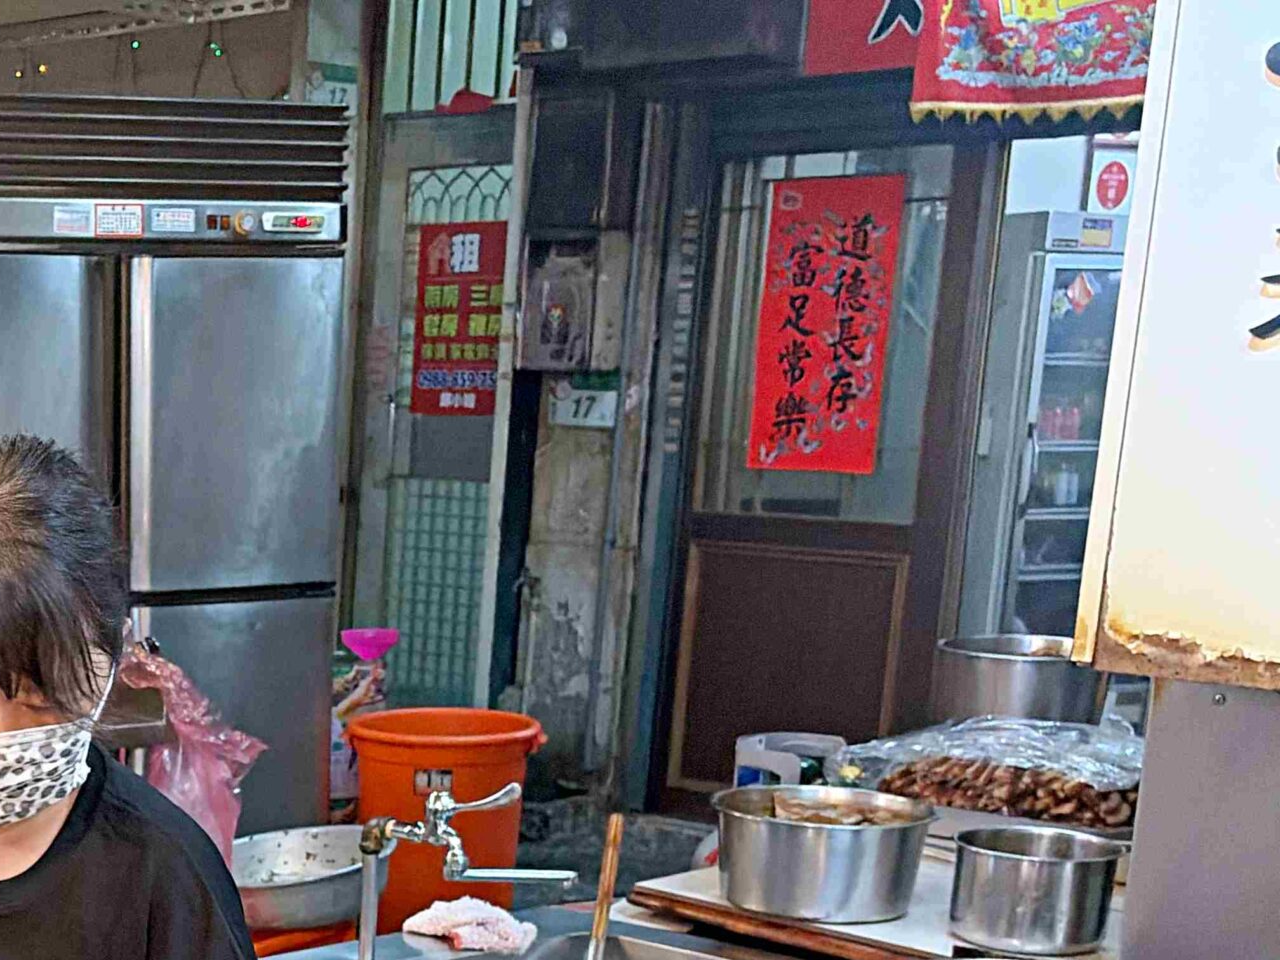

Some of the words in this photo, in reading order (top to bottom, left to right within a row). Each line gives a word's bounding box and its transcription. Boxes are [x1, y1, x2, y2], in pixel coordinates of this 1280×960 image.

[451, 233, 480, 273] 租
[771, 241, 824, 440] 富足常樂
[826, 213, 876, 414] 道德長存
[572, 396, 597, 419] 17
